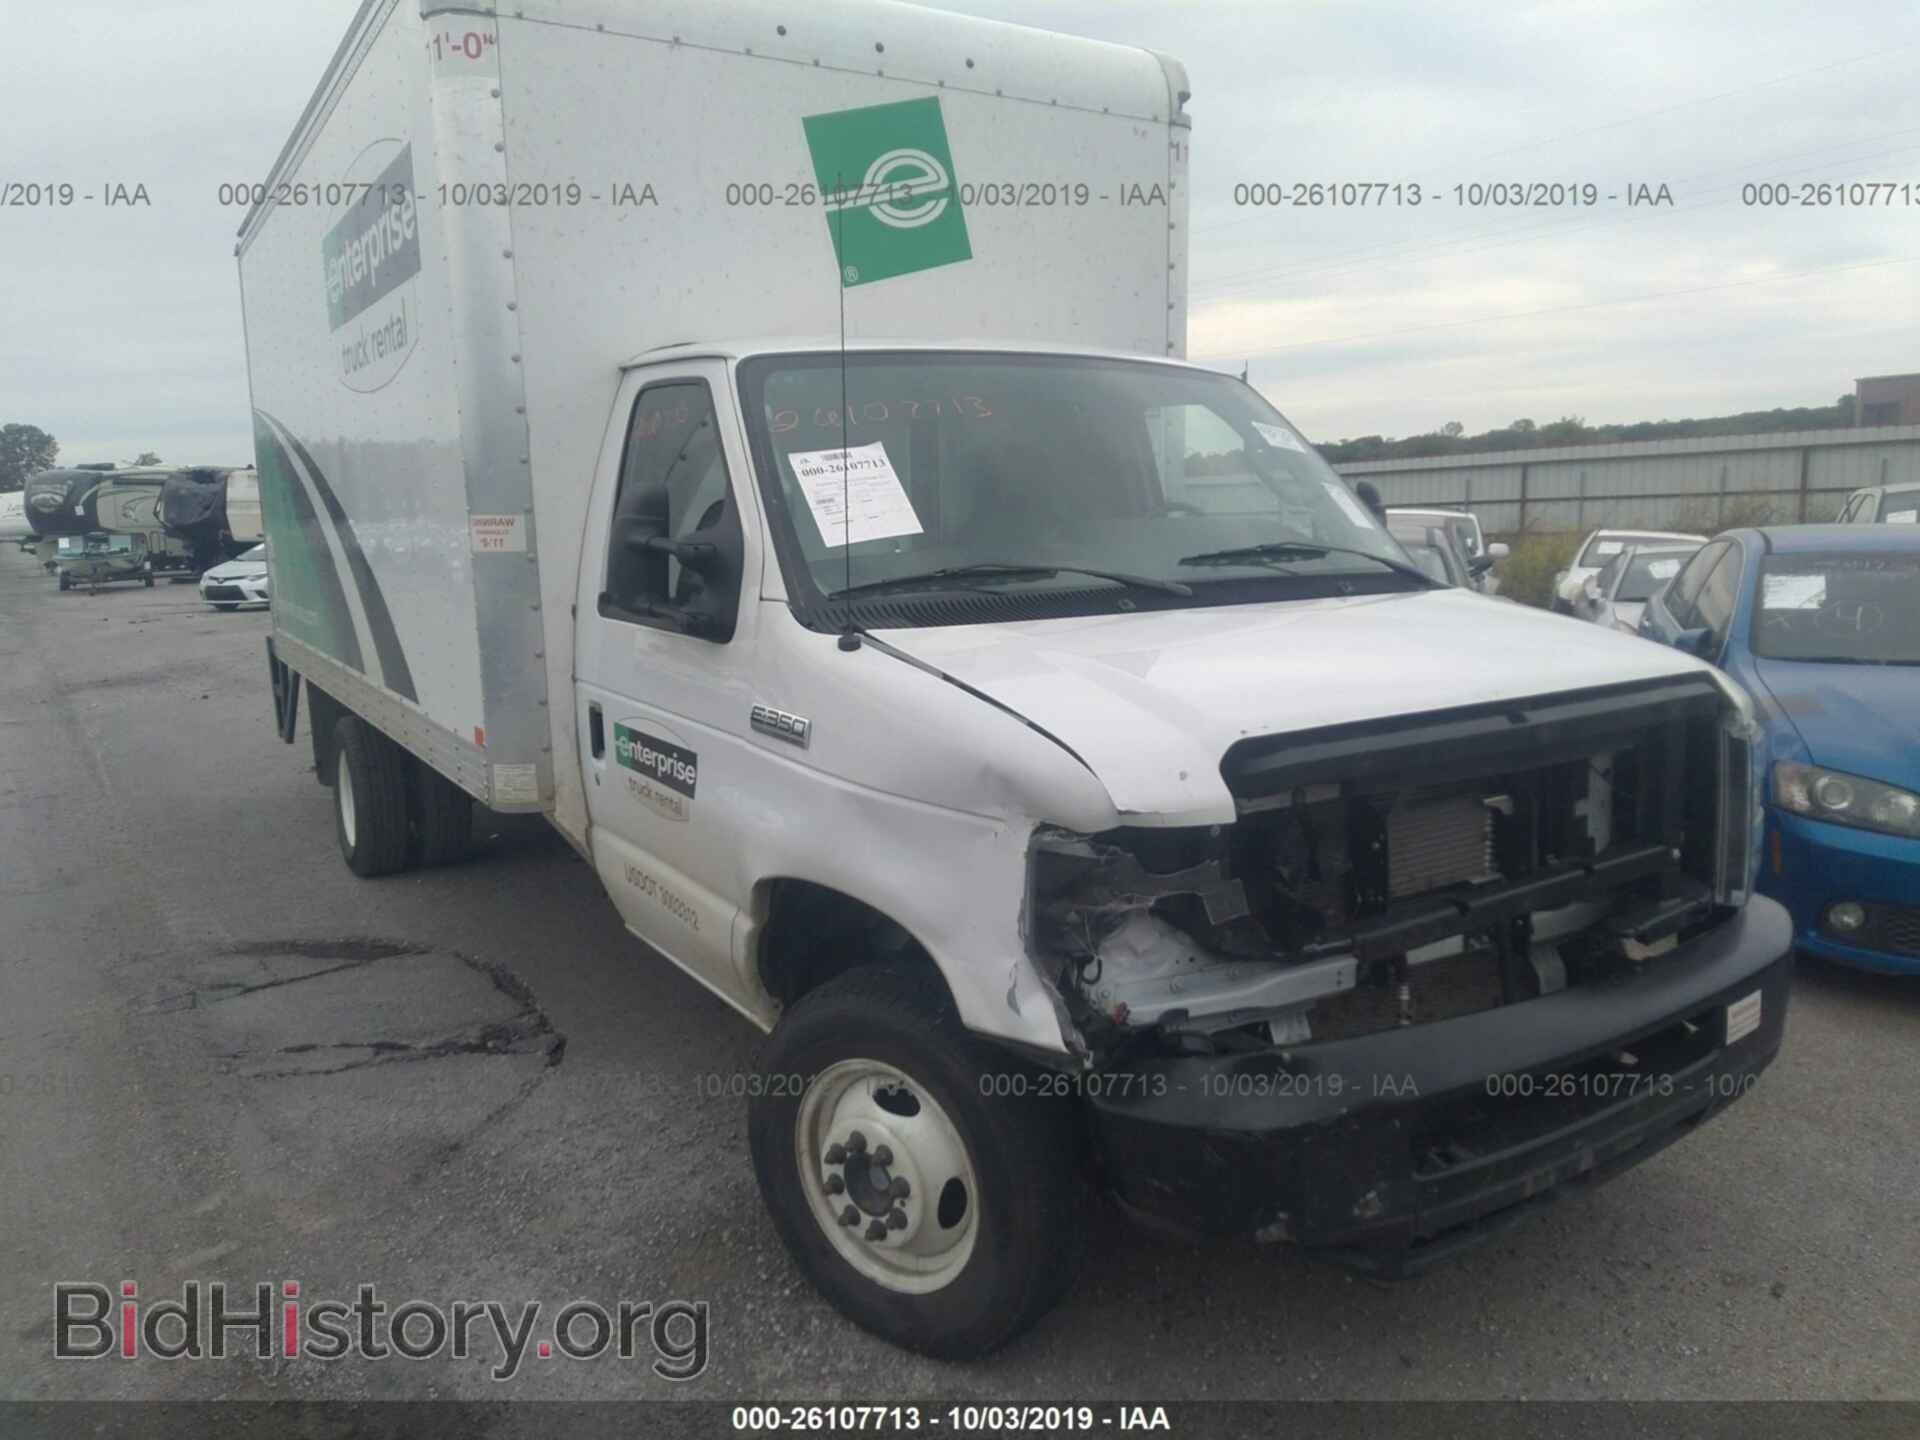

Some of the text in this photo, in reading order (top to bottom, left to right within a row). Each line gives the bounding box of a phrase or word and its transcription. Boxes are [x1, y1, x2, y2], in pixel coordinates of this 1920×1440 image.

[327, 190, 415, 303] enterprise
[371, 297, 408, 361] rental
[616, 736, 696, 785] enterprise
